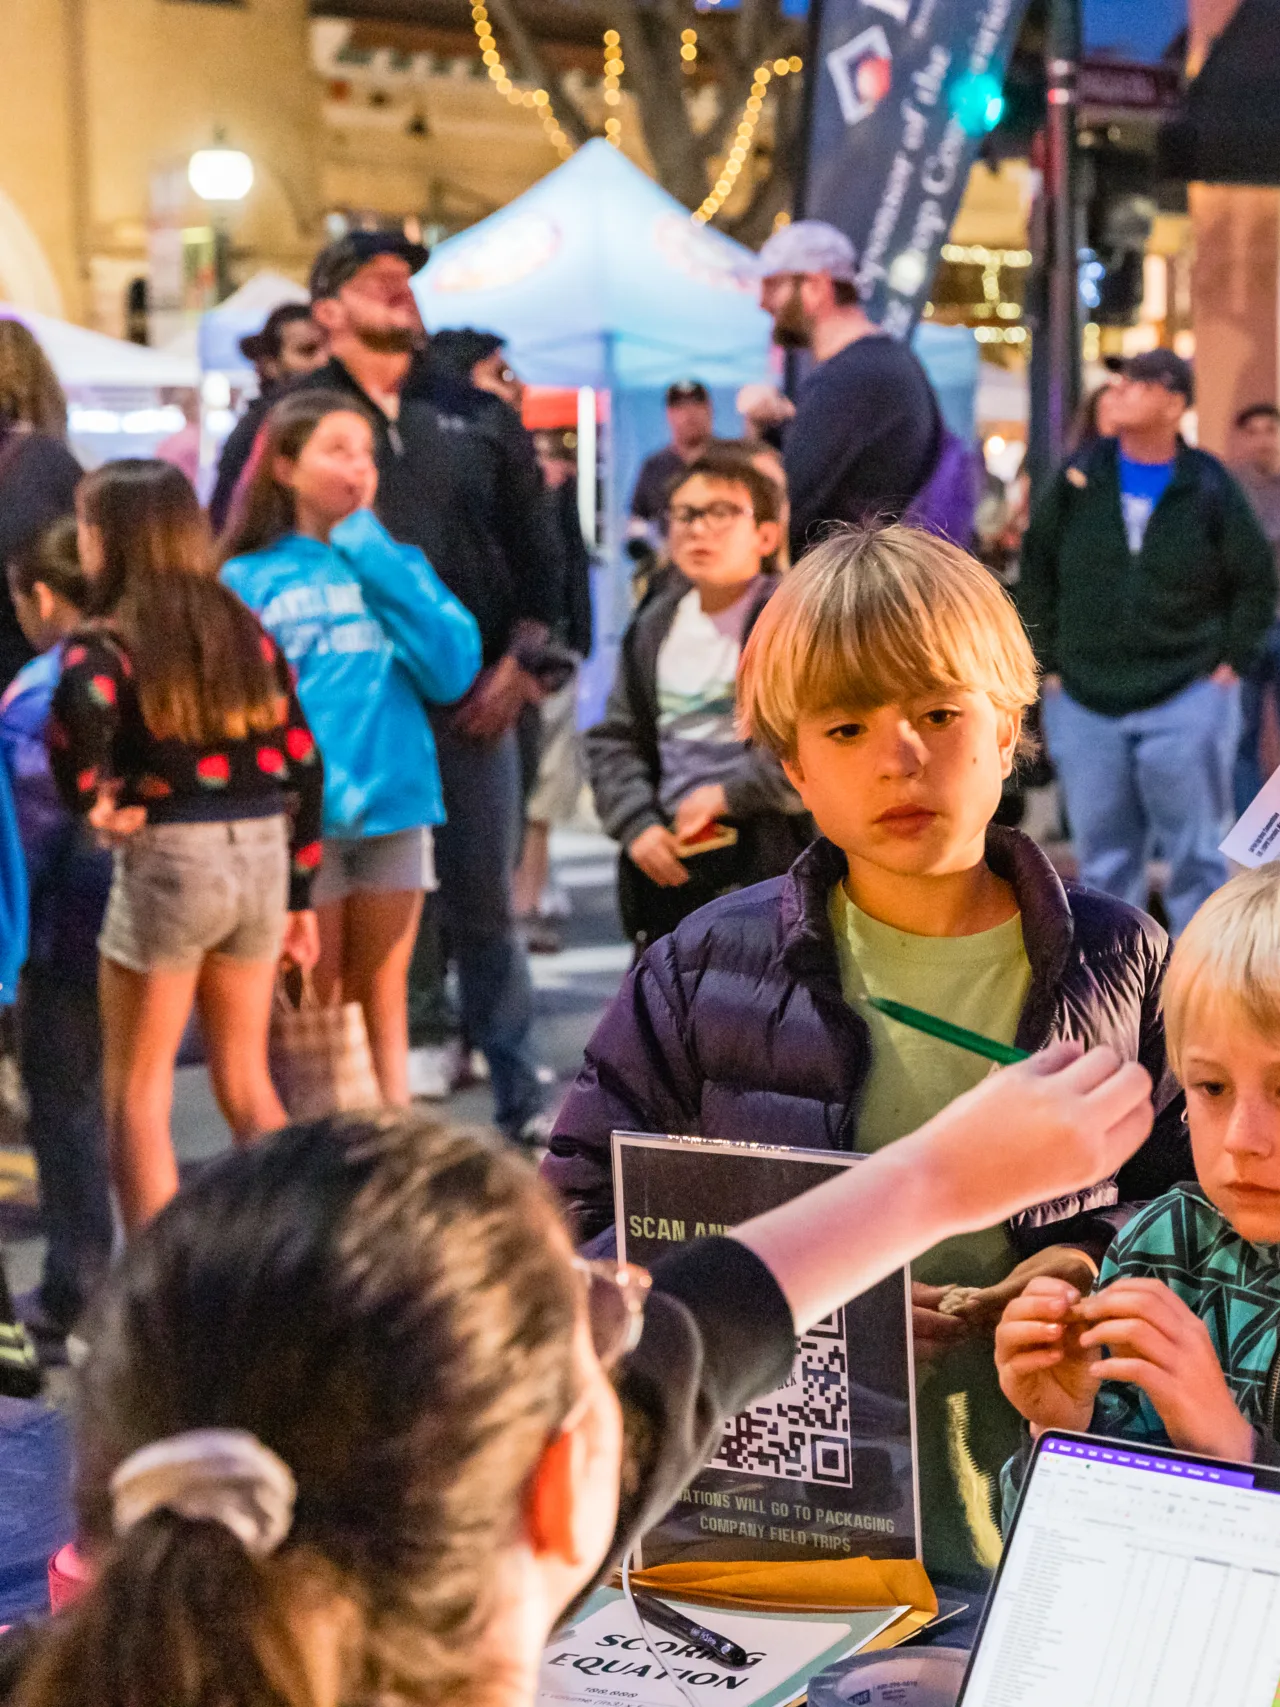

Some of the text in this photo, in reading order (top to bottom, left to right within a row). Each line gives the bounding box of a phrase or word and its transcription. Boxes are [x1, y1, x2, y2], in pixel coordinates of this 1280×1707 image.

[629, 1215, 730, 1242] SCAN AN
[700, 1515, 852, 1553] COMPANY FIELD TRIPS
[735, 1496, 767, 1514] WILL
[771, 1501, 789, 1517] GO
[793, 1505, 811, 1520] TO
[816, 1508, 895, 1534] PACKAGING
[548, 1652, 749, 1690] EQUATION
